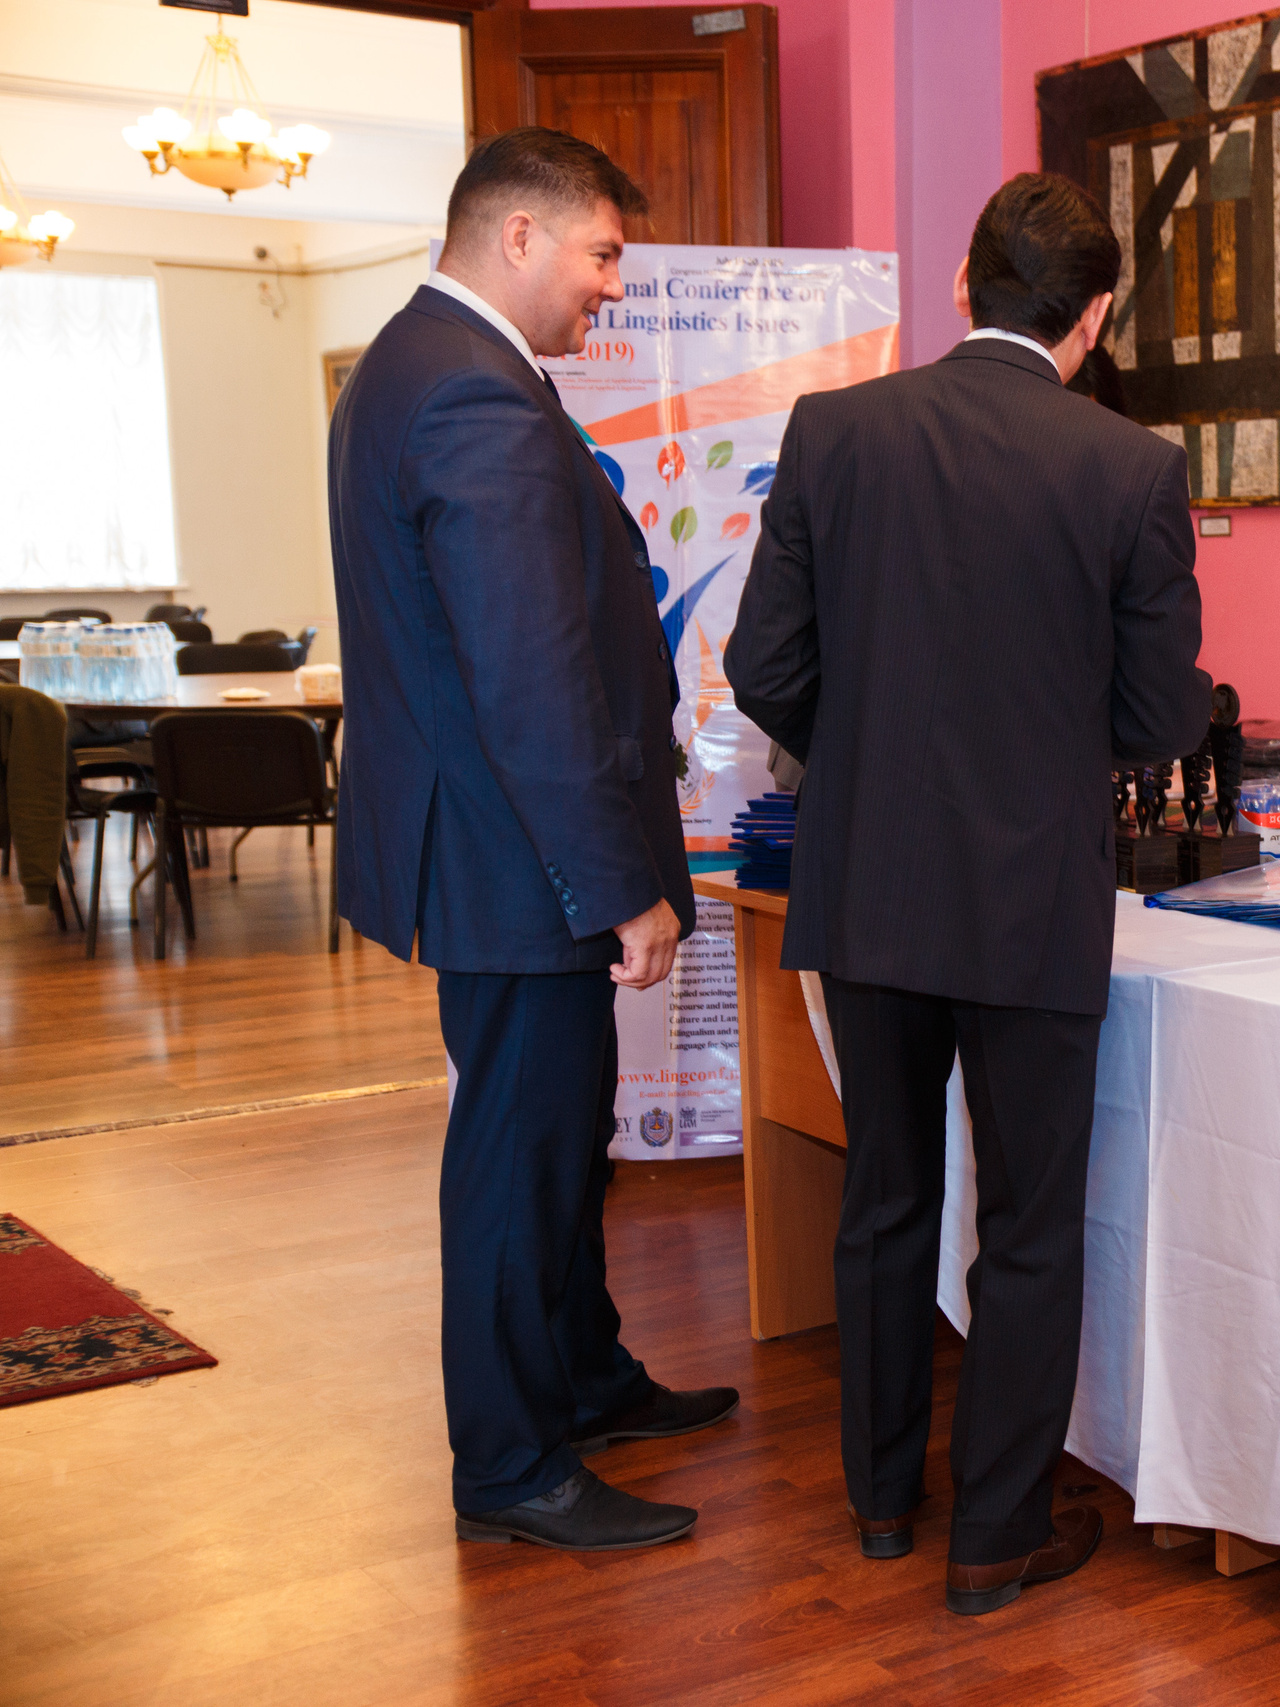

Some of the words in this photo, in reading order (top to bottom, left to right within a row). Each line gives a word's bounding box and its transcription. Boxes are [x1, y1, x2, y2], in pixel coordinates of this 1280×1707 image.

[624, 278, 658, 298] nal
[666, 277, 793, 301] Conference
[800, 286, 826, 303] on
[608, 309, 728, 336] Linguistics
[736, 312, 800, 333] Issues
[670, 990, 698, 1000] Applied
[669, 1002, 704, 1010] Discourse
[670, 1028, 715, 1038] Bilingualism
[670, 1042, 706, 1051] Language
